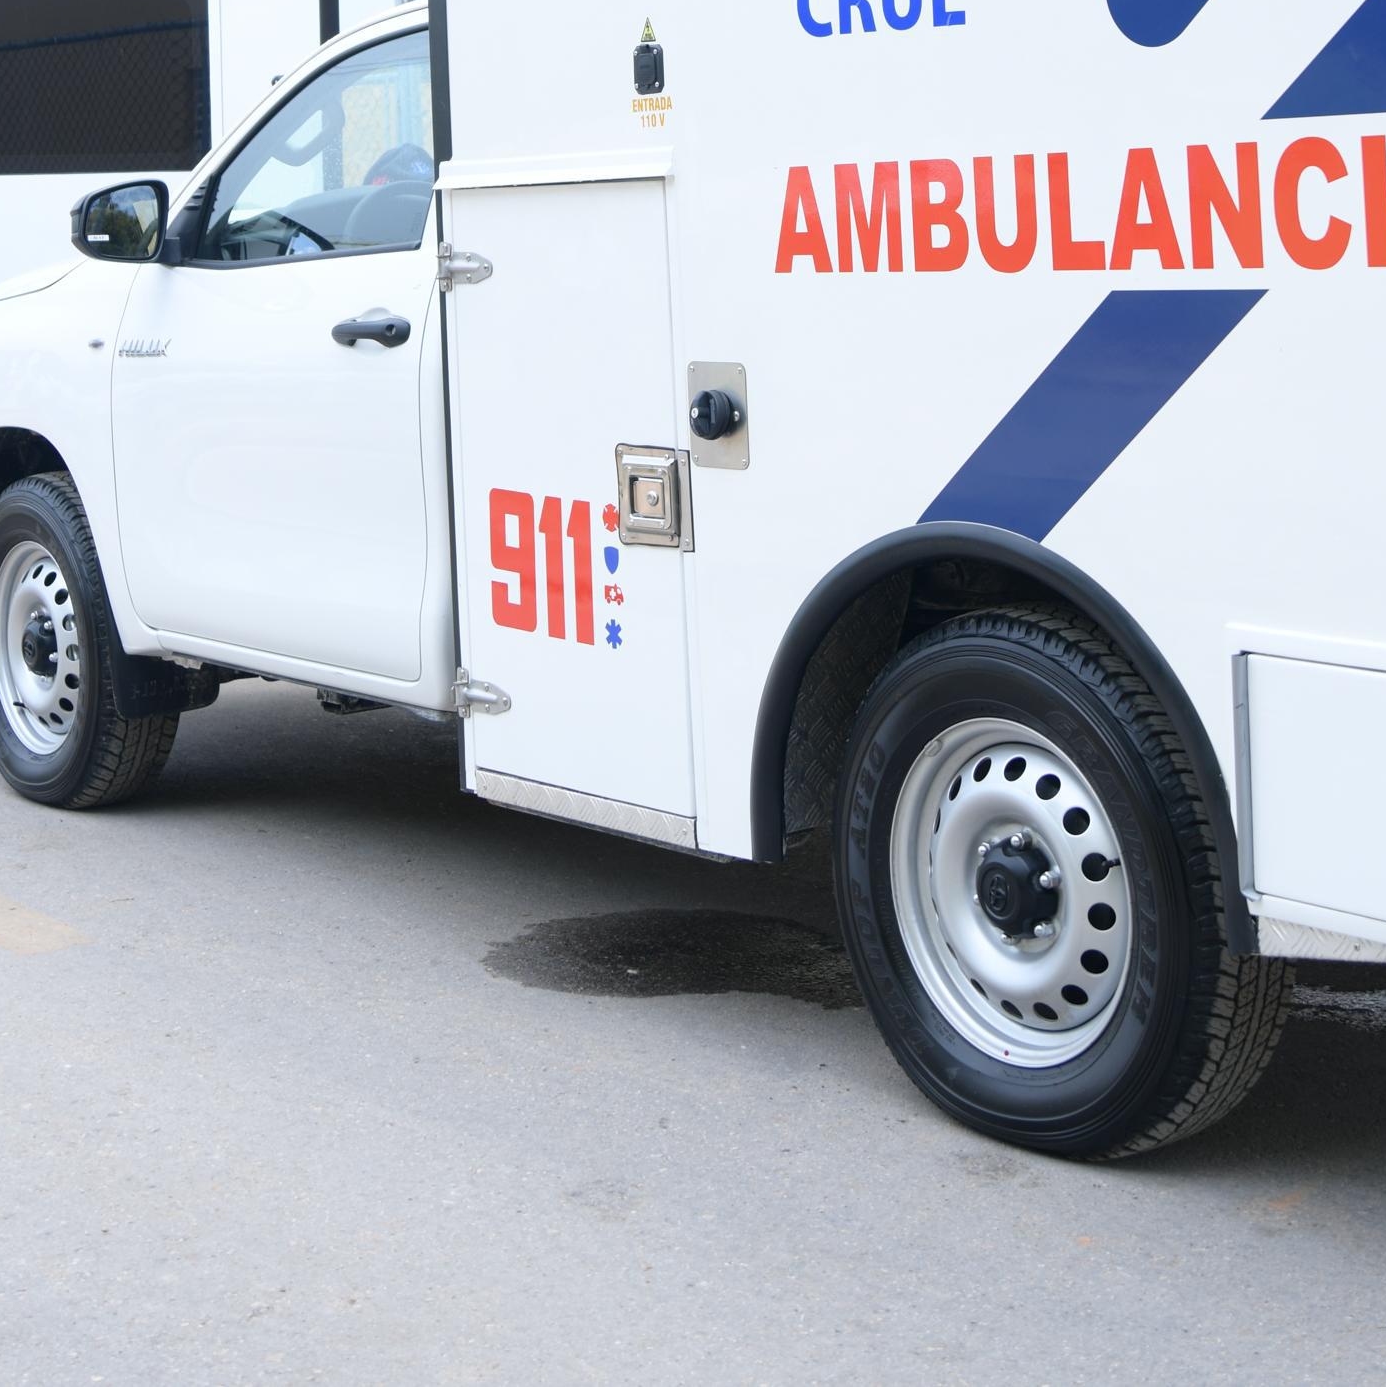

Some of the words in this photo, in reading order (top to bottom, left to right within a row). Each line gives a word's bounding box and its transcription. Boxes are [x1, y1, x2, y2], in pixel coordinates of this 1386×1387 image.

[633, 97, 672, 112] ENTRADA
[641, 115, 656, 127] 110
[659, 114, 665, 126] V
[489, 487, 595, 647] 911
